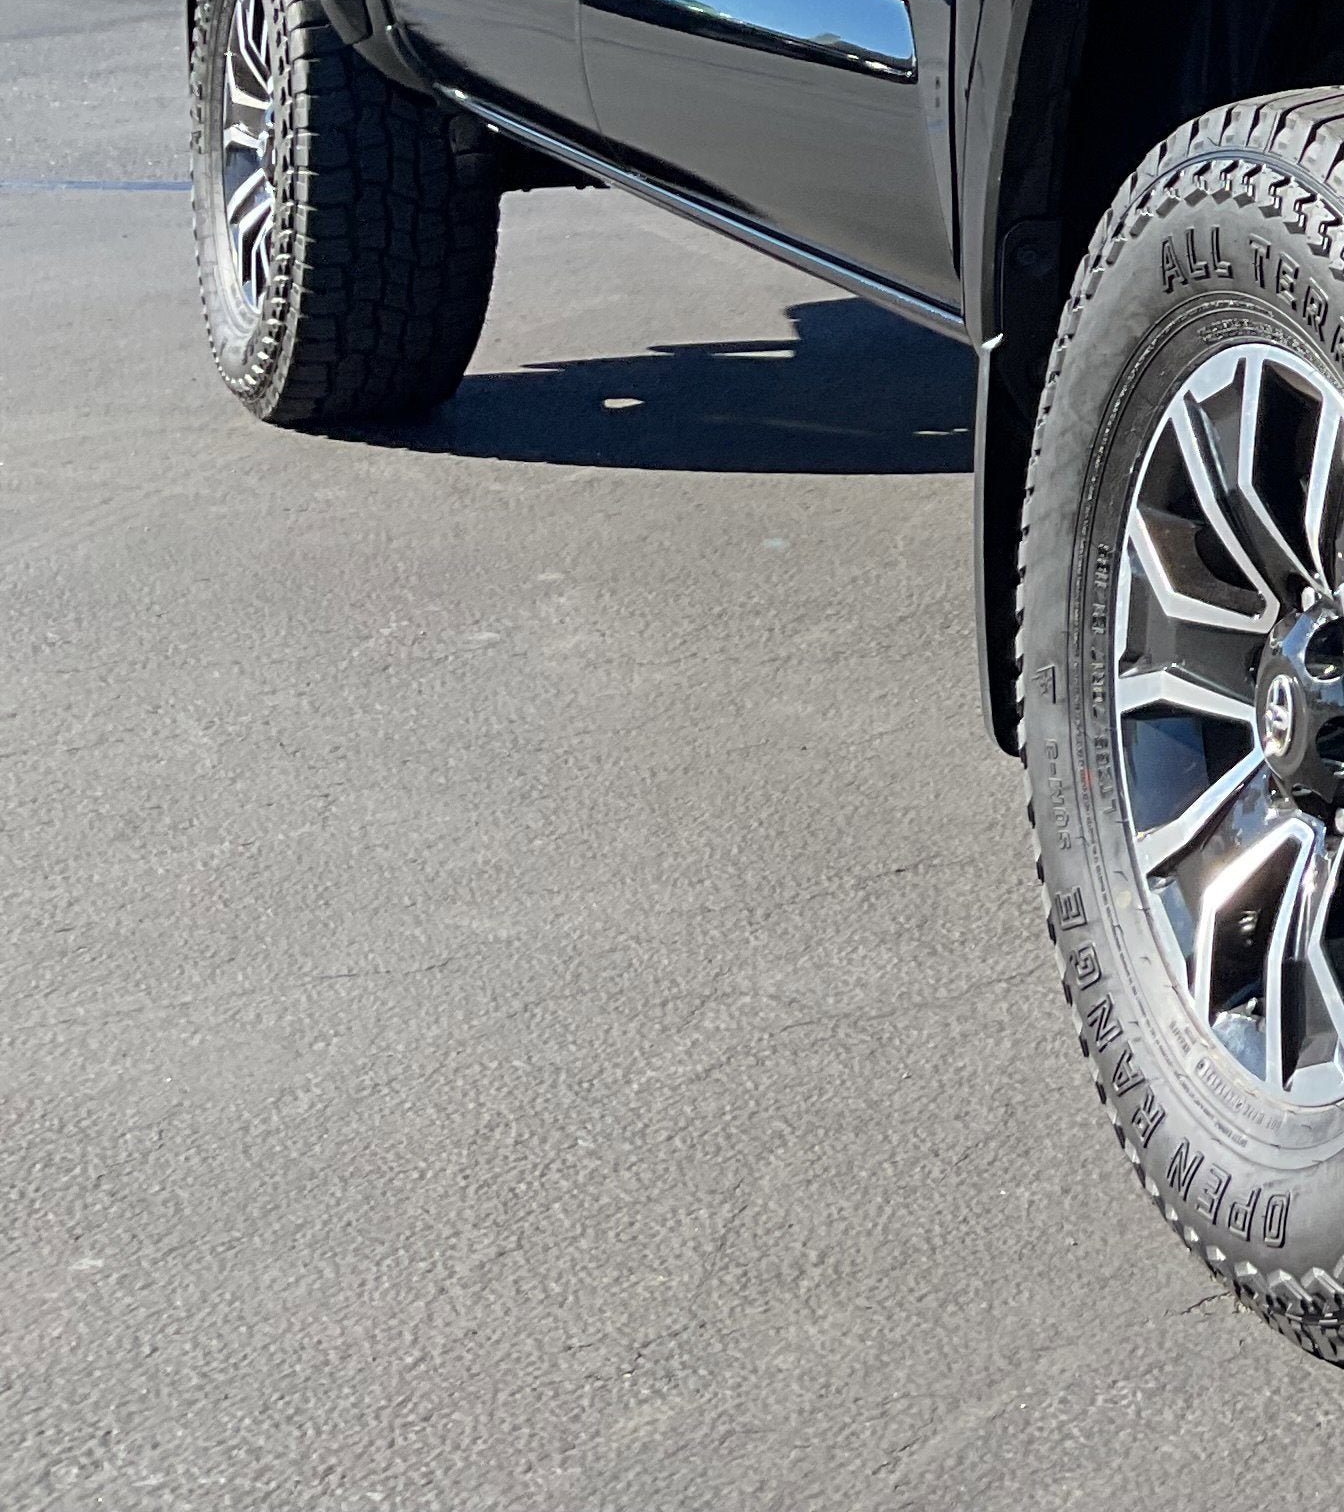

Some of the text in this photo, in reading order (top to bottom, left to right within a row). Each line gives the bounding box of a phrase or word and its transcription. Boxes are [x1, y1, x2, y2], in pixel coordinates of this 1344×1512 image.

[1160, 223, 1235, 295] ALL
[1055, 886, 1167, 1150] RANGE
[1166, 1136, 1293, 1248] OPEN
